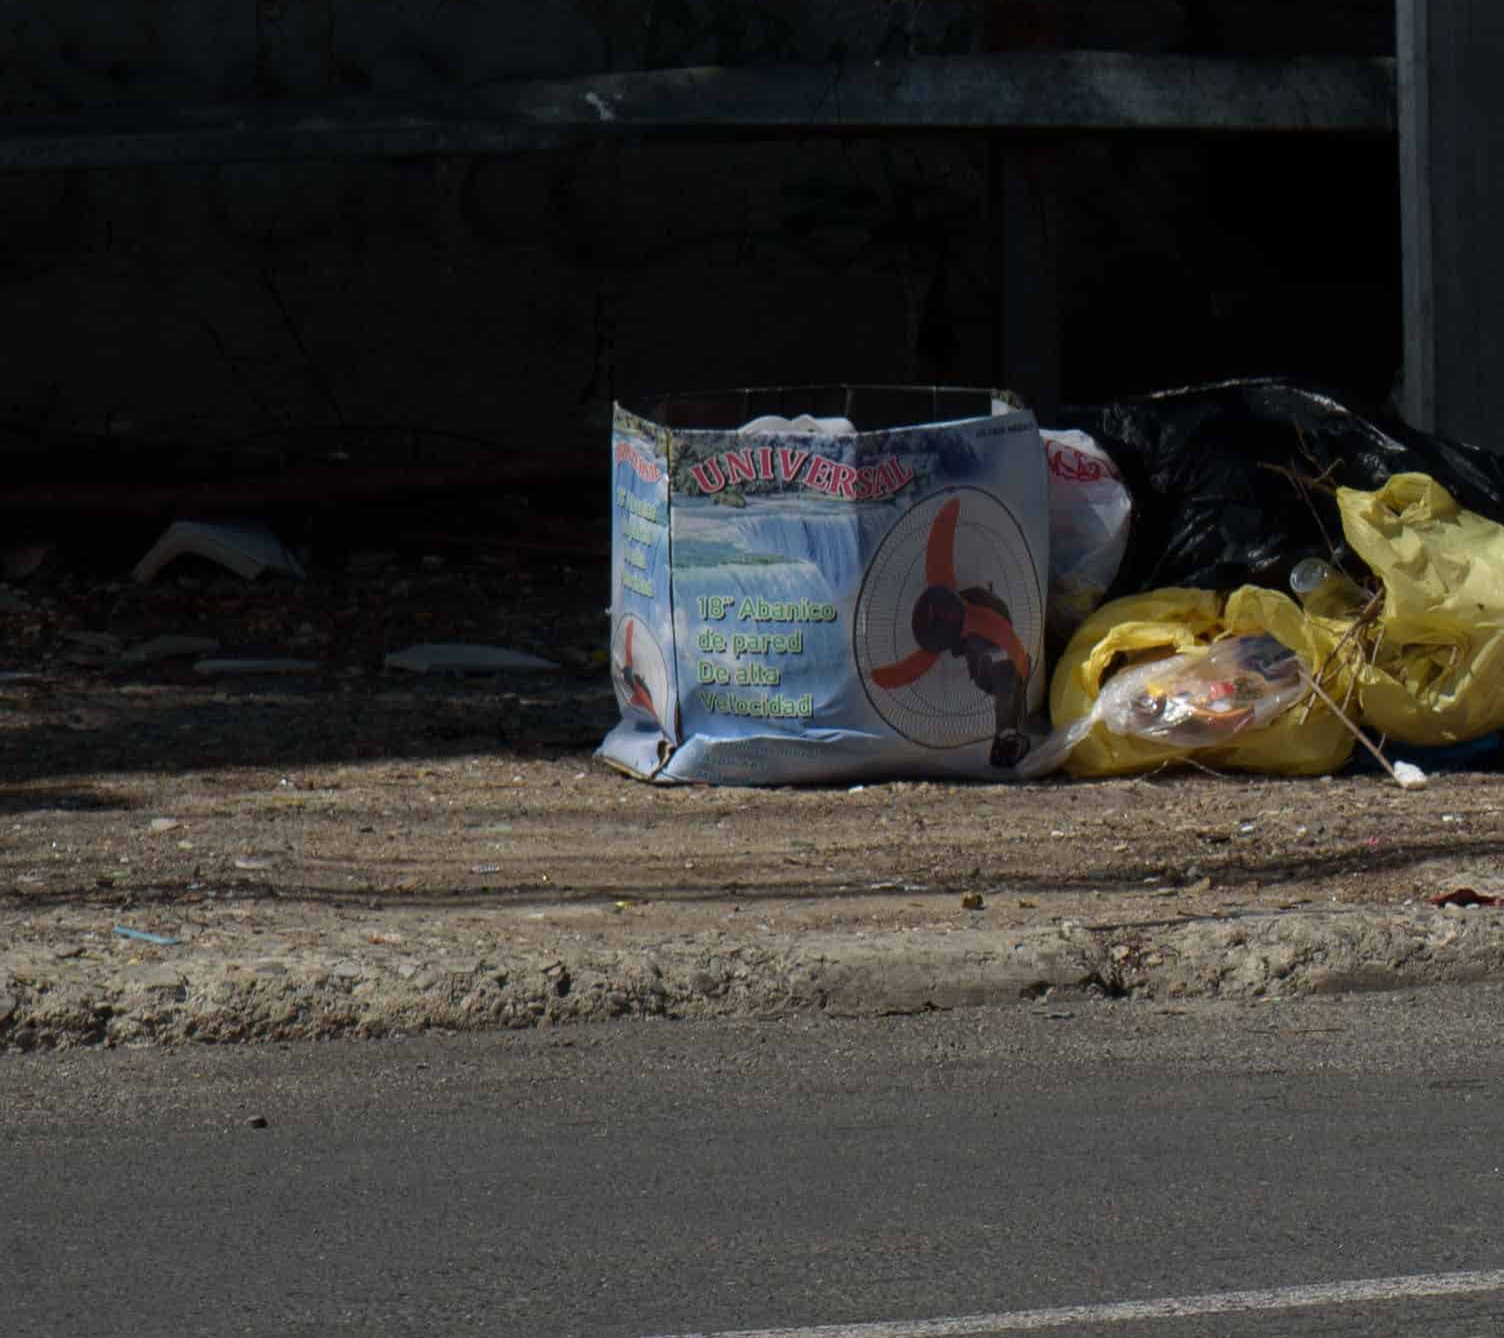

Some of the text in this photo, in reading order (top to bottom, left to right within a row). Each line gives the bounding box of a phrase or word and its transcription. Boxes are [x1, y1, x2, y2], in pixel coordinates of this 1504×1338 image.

[689, 446, 914, 501] UNIVERSAL
[697, 595, 838, 622] 18" Abanico
[698, 628, 804, 660] de pared
[698, 661, 781, 686] De alta
[700, 692, 814, 718] Velocidad
